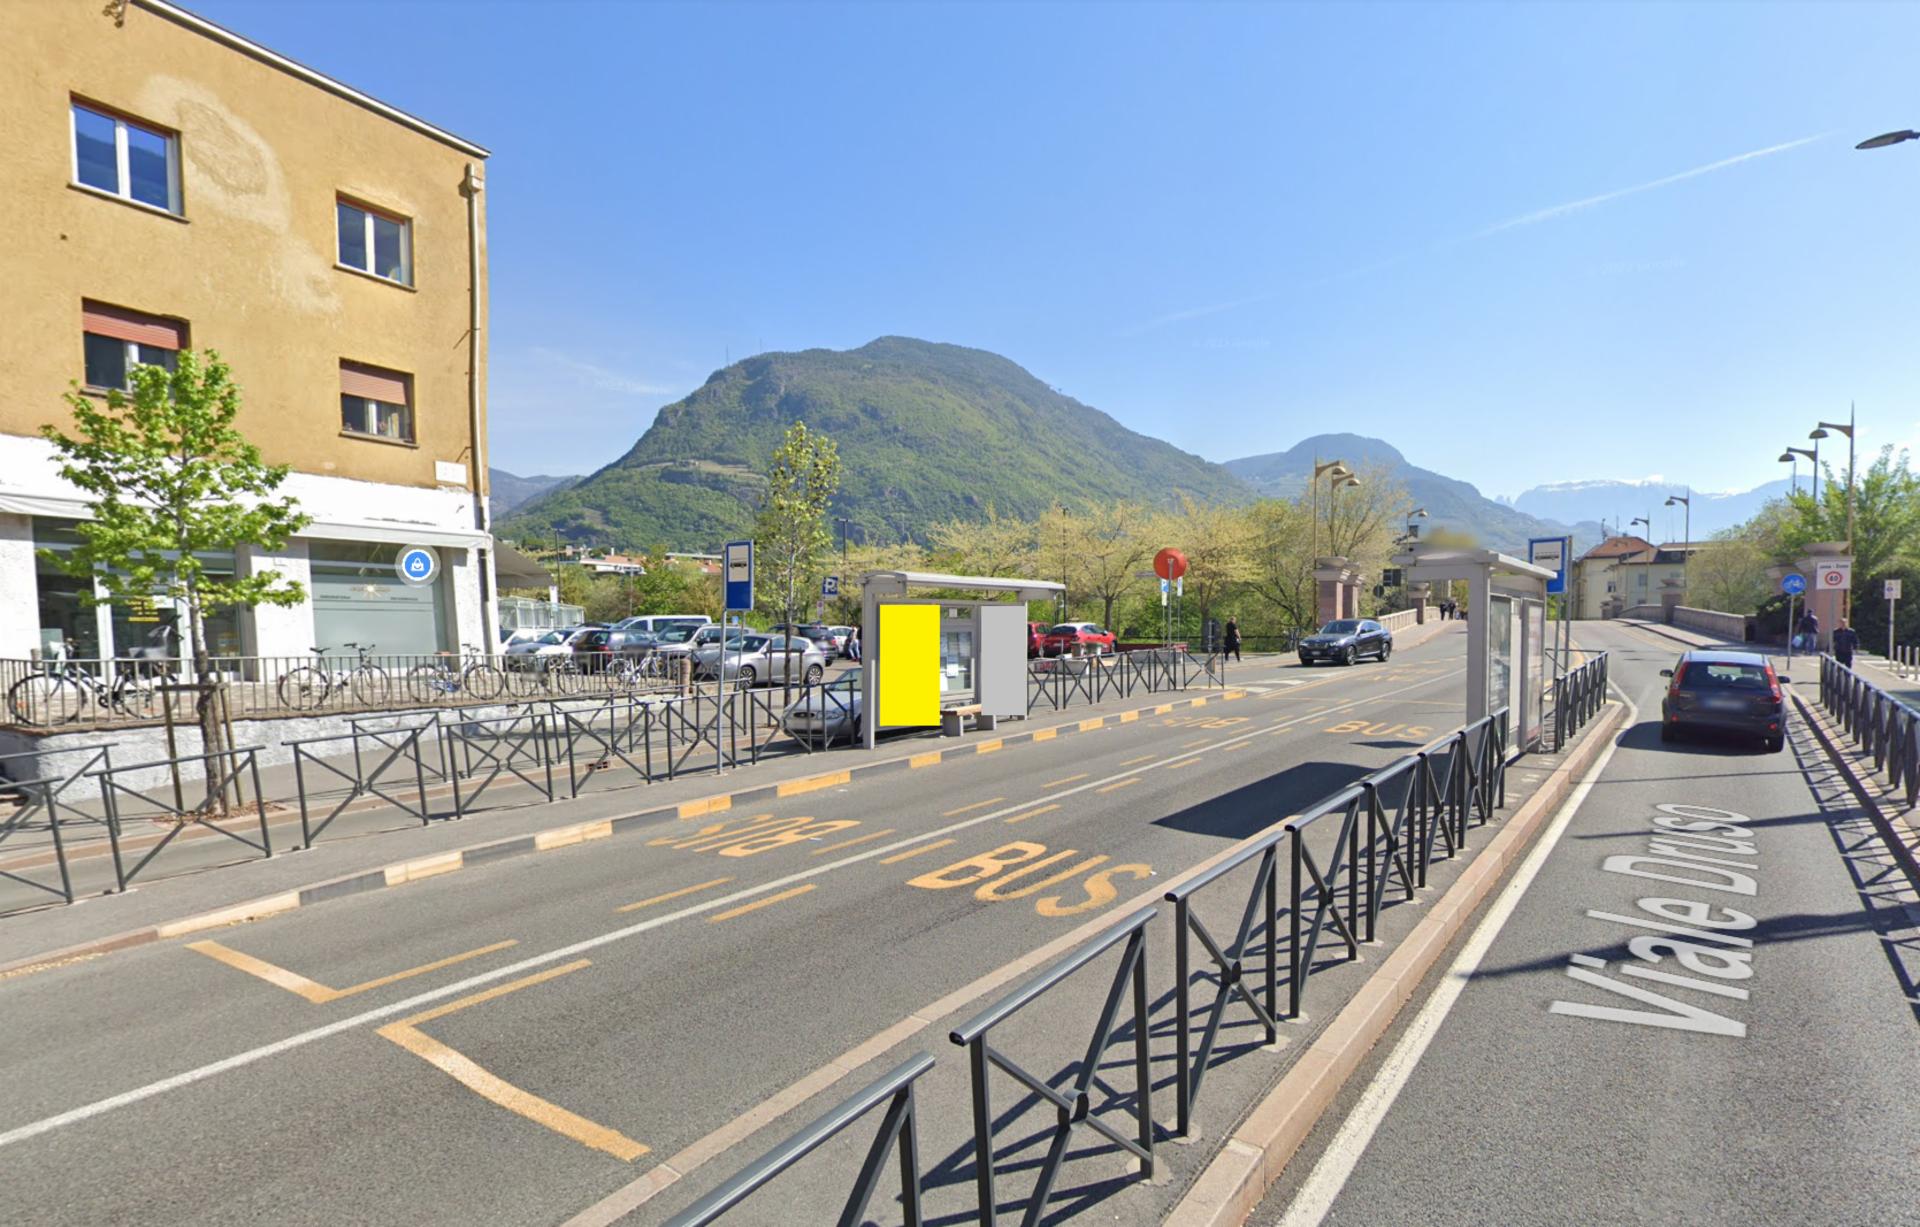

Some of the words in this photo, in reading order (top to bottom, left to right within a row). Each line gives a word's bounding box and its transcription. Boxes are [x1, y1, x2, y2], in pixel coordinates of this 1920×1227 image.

[1324, 721, 1433, 739] BUS
[645, 814, 862, 857] BUS
[1603, 803, 1759, 896] Druso
[905, 841, 1153, 917] BUS
[1549, 897, 1758, 1037] Viale
